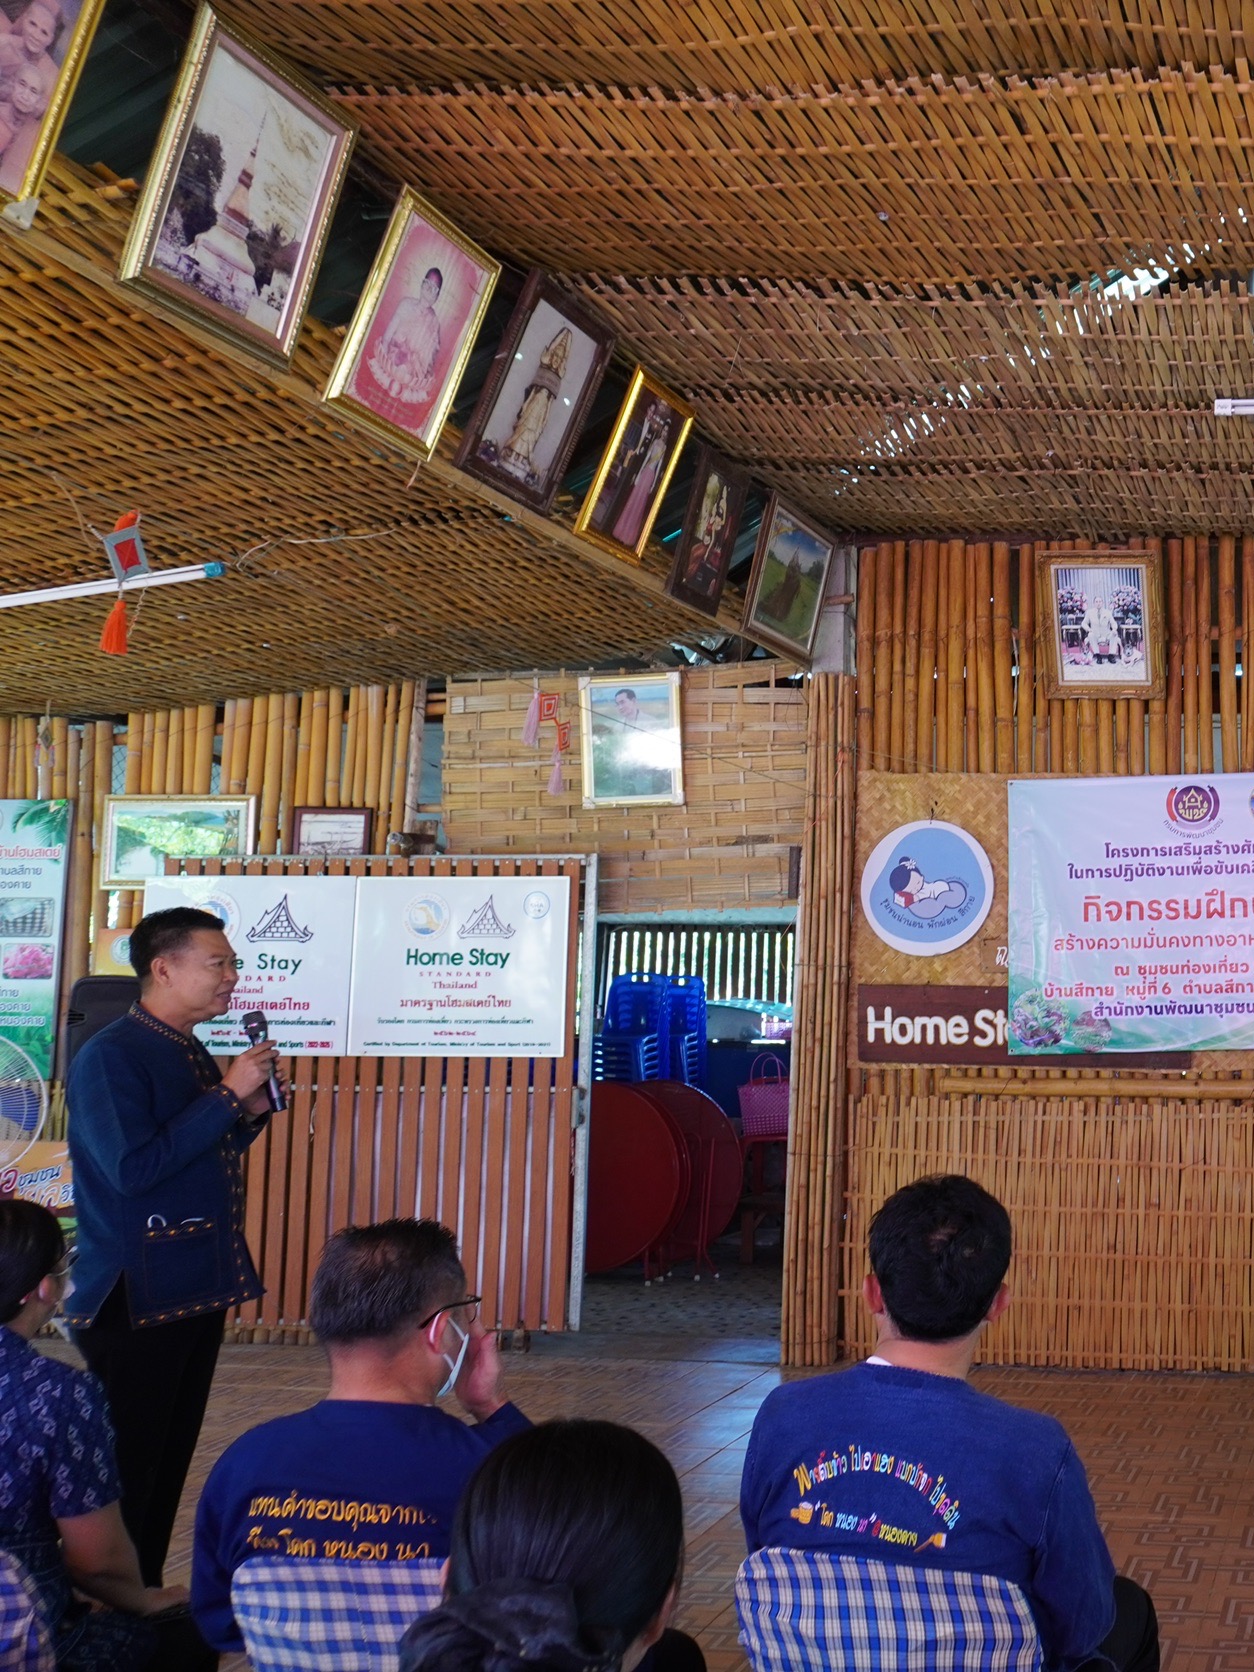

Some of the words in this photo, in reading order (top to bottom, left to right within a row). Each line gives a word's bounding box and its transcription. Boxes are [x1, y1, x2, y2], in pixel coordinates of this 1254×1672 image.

[256, 952, 303, 975] Stay
[405, 948, 464, 966] Home
[468, 948, 511, 969] Stay
[1114, 964, 1130, 977] ณ
[1137, 955, 1250, 980] ชุมชนท่องเที่ยว
[431, 981, 479, 989] Thailand
[1044, 982, 1115, 999] บ้านสีกาย
[1125, 976, 1158, 1001] หมู่ที่
[1161, 982, 1172, 996] 6
[865, 1004, 970, 1046] Home
